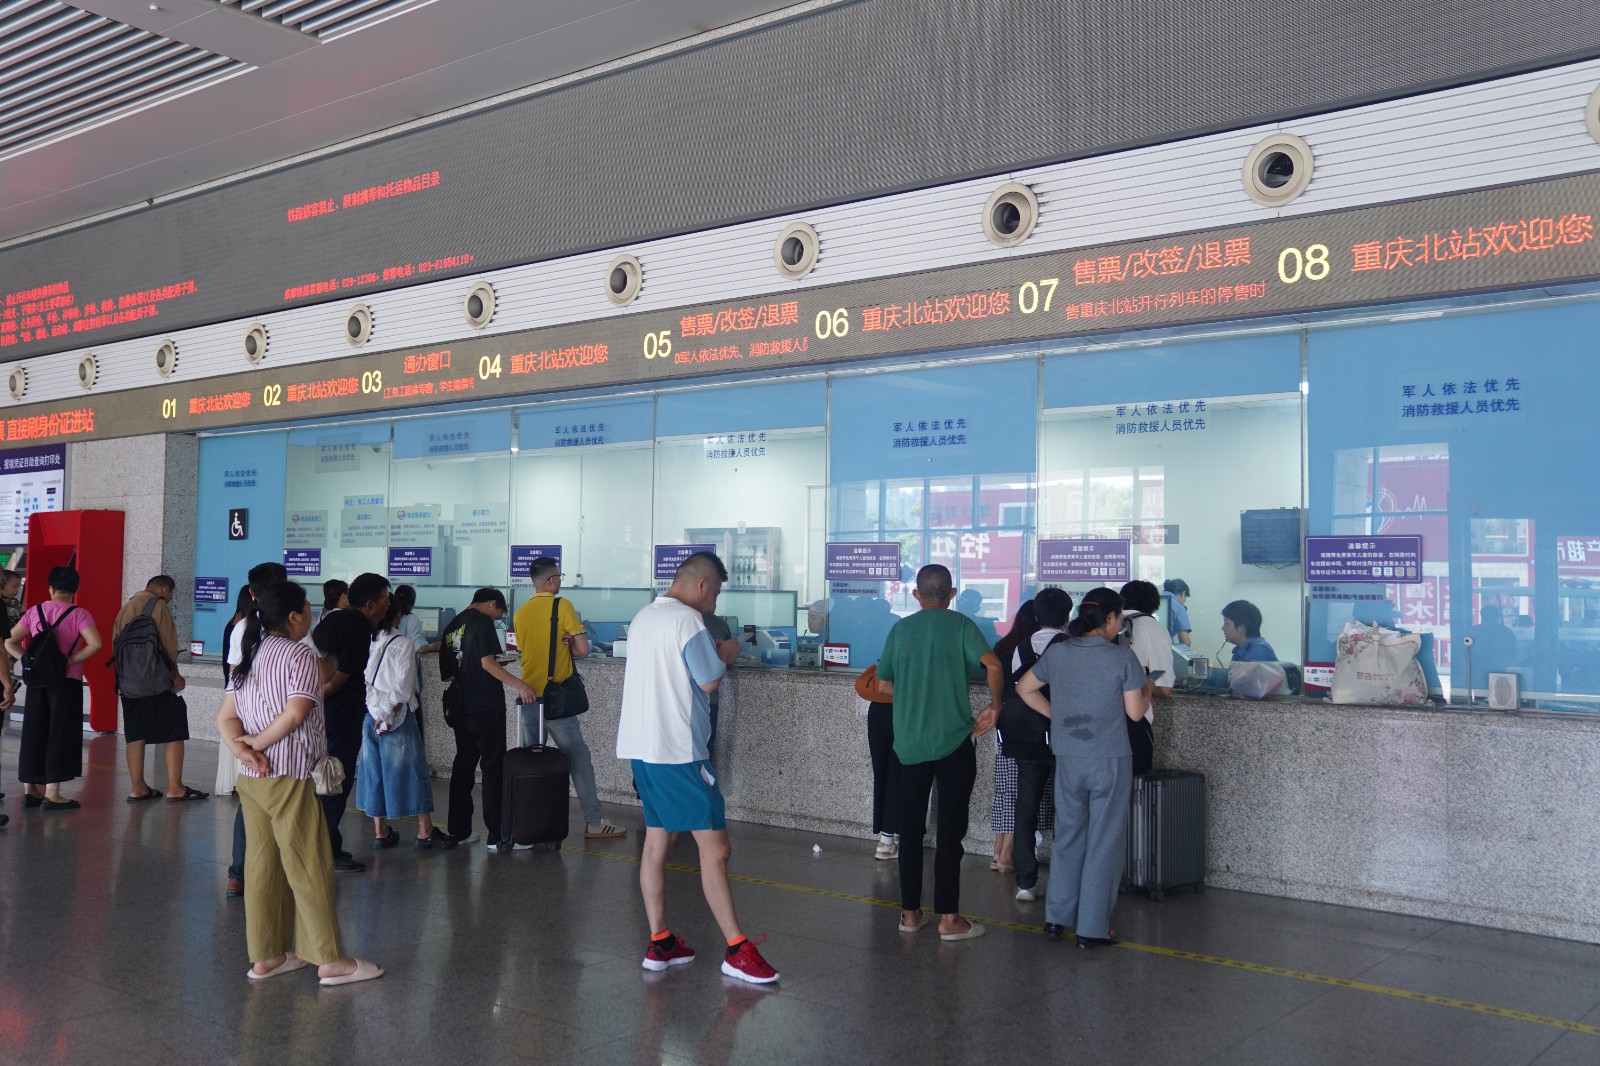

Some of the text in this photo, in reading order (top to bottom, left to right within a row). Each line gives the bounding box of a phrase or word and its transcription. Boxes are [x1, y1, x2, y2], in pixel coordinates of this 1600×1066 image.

[287, 171, 440, 222] 铁路旅客禁止、限制携带和托运物品目录
[1351, 213, 1594, 272] 重庆北站欢迎您
[1072, 237, 1252, 286] 售票/改签/退票
[1278, 244, 1330, 283] 08
[1018, 278, 1059, 314] 07
[680, 301, 799, 338] 售票/改签/退票
[815, 307, 849, 339] 06
[862, 291, 1010, 332] 重庆北站欢迎您
[643, 330, 672, 360] 05
[403, 350, 452, 374] 通办窗口
[478, 353, 502, 380] 04
[509, 344, 609, 374] 重庆北站欢迎您
[286, 377, 360, 402] 重庆北站欢迎您
[361, 370, 382, 394] 03
[1402, 377, 1521, 399] 军人依法优先
[188, 391, 252, 414] 重庆北站欢迎您
[263, 384, 281, 407] 02
[162, 398, 177, 419] 01
[1115, 400, 1206, 418] 军人依法优先
[1402, 398, 1521, 419] 消防救援人员优先
[6, 408, 95, 441] 直接刷身份证进站
[555, 423, 606, 435] 军人依法优先
[892, 418, 967, 433] 军人依法优先
[1115, 418, 1206, 435] 消防救援人员优先
[554, 436, 605, 448] 消防救援人员优先
[706, 432, 767, 445] 军人依法优先
[892, 434, 967, 449] 消防救援人员优先
[706, 447, 766, 460] 消防救援人员优先
[1347, 542, 1377, 550] 温馨提示
